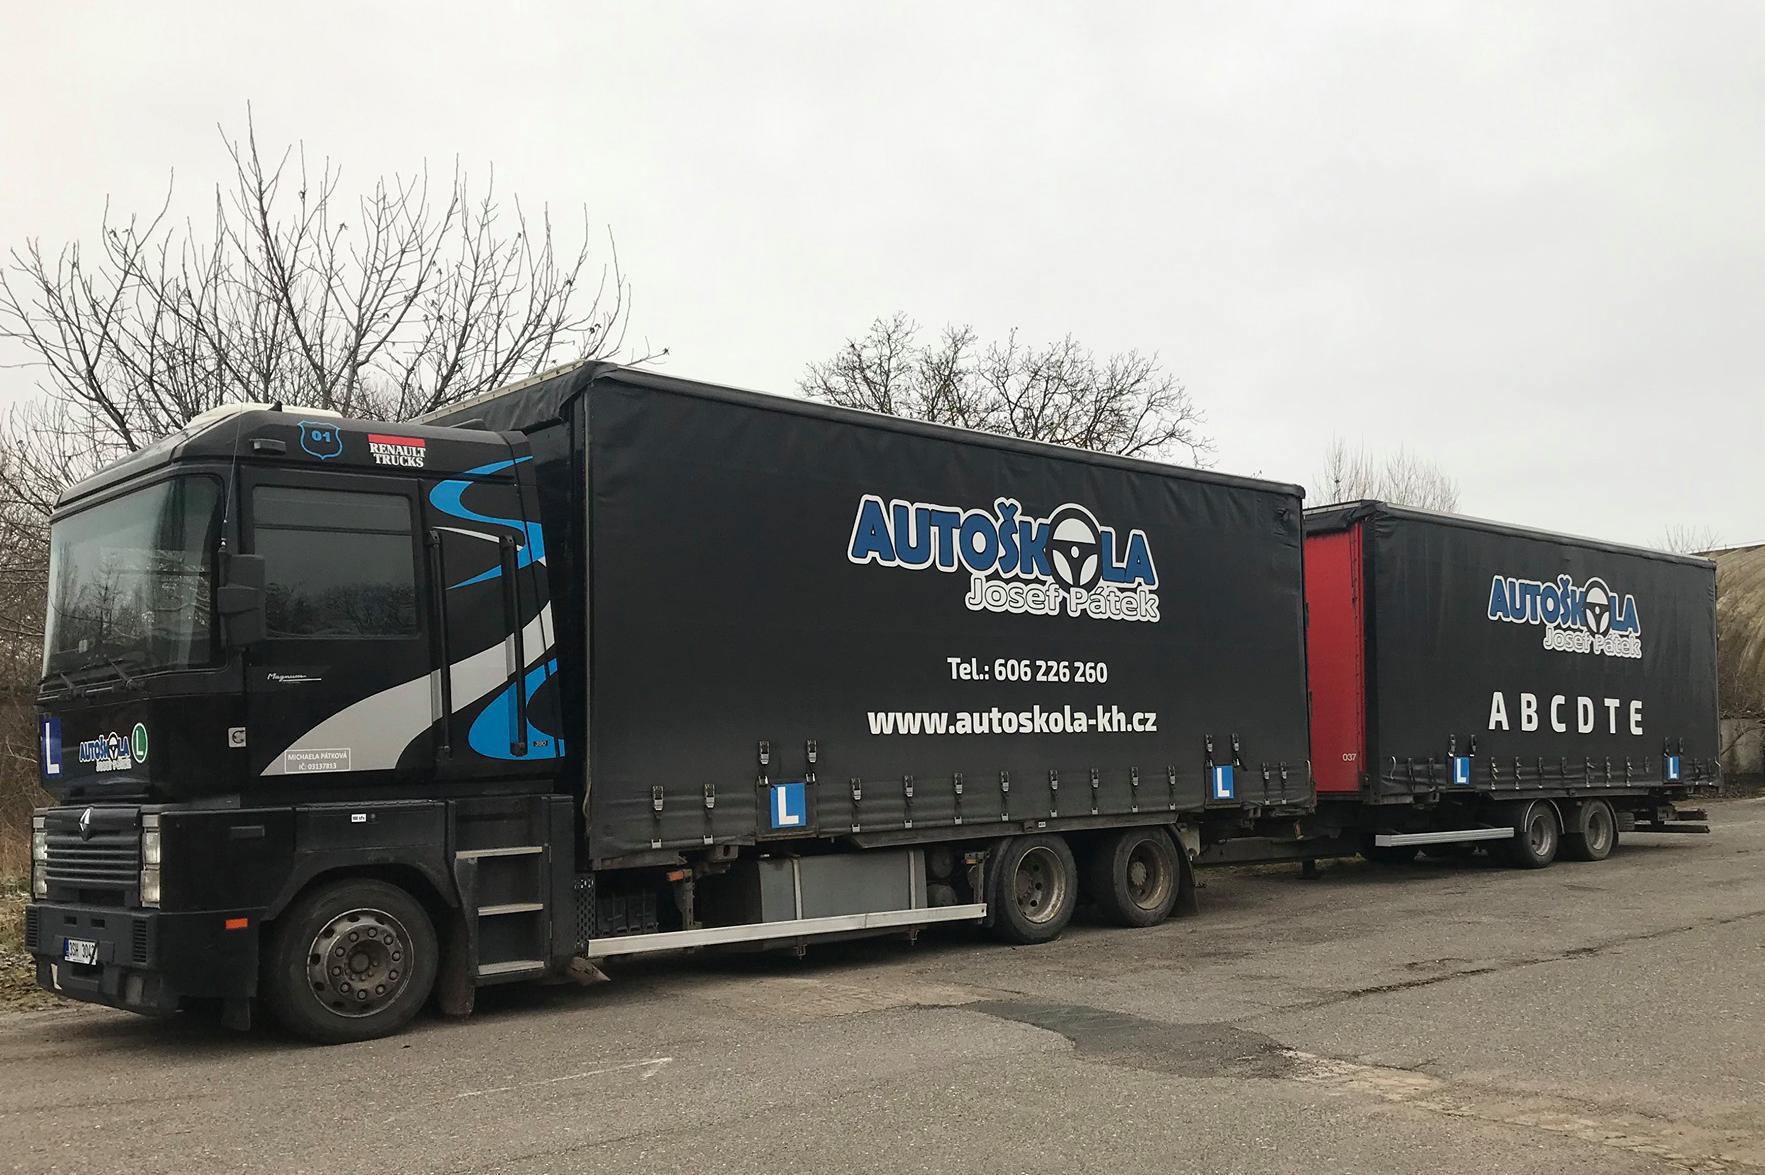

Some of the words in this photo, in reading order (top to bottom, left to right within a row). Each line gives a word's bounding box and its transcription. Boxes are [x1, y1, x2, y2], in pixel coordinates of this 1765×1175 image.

[311, 430, 331, 443] 01
[368, 443, 426, 458] RENAULT
[373, 454, 424, 468] TRUCKS
[966, 573, 1062, 614] Josef
[1064, 583, 1161, 622] Pátek
[1544, 626, 1593, 653] Josef
[1594, 632, 1642, 659] Pátek
[947, 657, 989, 680] Tel.:
[994, 659, 1031, 681] 606
[1036, 660, 1070, 682] 226
[1074, 661, 1107, 683] 260
[867, 705, 1157, 734] www.autoskola-kh.cz
[1488, 691, 1509, 730] A
[1520, 693, 1538, 731] B
[1551, 695, 1566, 733] C
[1577, 696, 1594, 734] D
[1604, 698, 1620, 734] T
[1630, 700, 1643, 735] E
[45, 722, 60, 774] L
[136, 730, 143, 755] L
[287, 753, 319, 761] MICHAELA
[1342, 753, 1357, 761] 037
[1668, 757, 1678, 780] L
[1216, 767, 1230, 797] L
[1456, 758, 1467, 783] L
[777, 786, 799, 825] L
